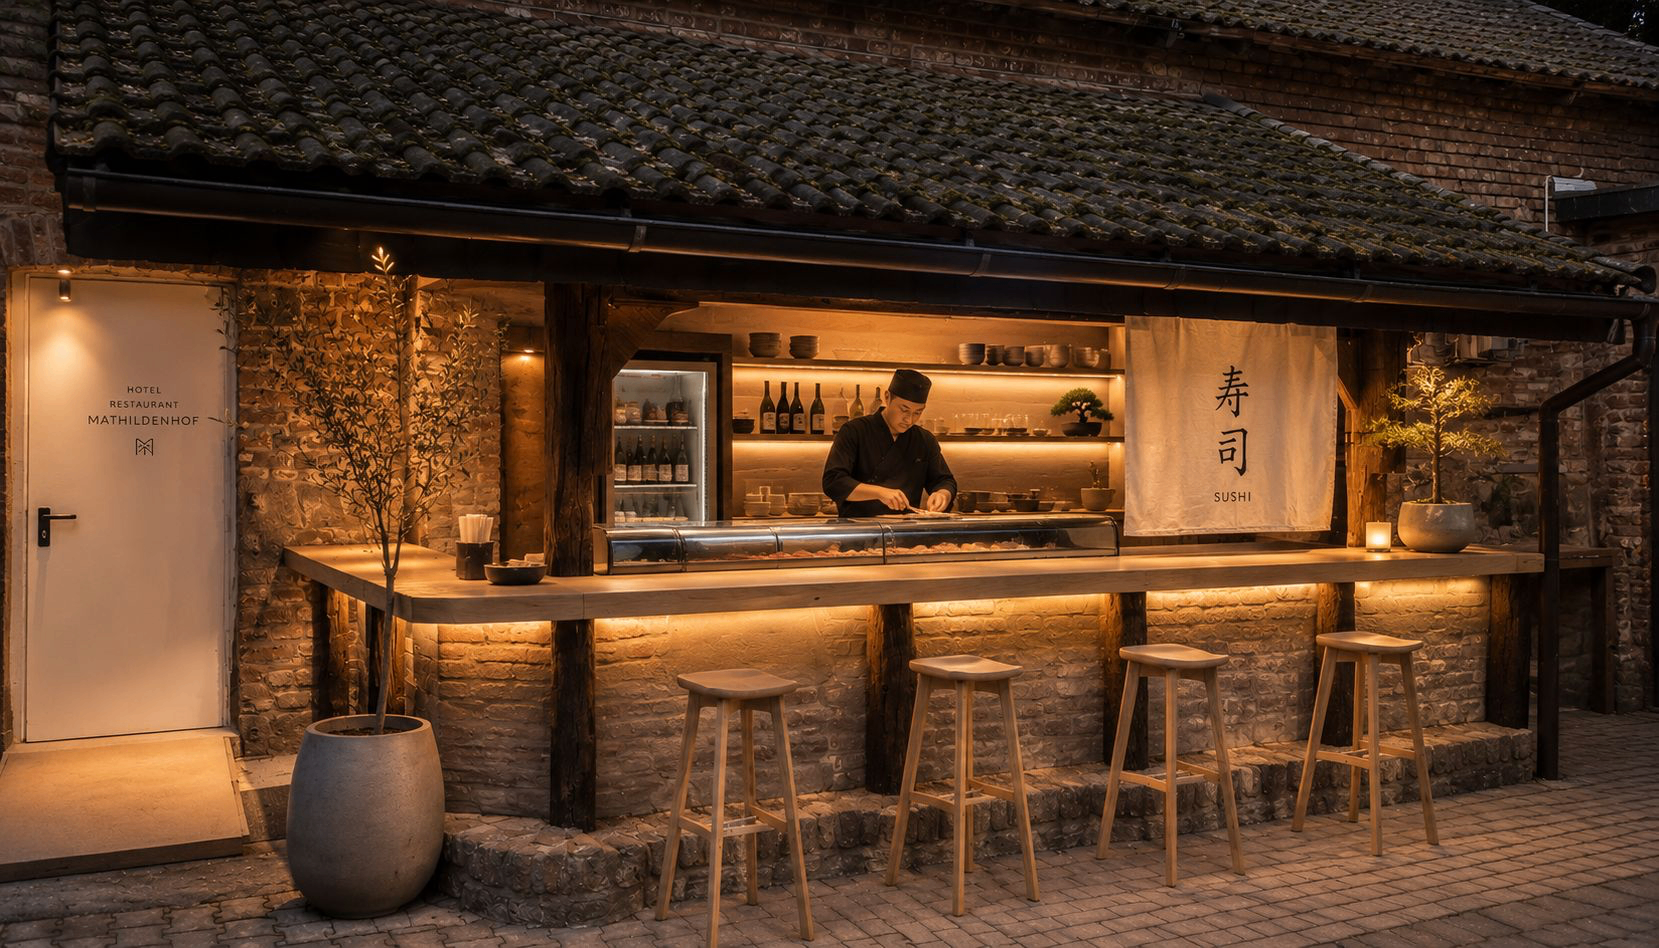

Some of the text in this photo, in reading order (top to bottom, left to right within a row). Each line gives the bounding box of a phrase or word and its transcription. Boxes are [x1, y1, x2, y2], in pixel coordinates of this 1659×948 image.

[127, 386, 162, 394] HOTEL
[109, 400, 180, 409] RESTAURANT
[87, 415, 200, 425] MATHILDENHOF
[1215, 365, 1249, 477] 寿司
[1214, 491, 1251, 502] SUSHI
